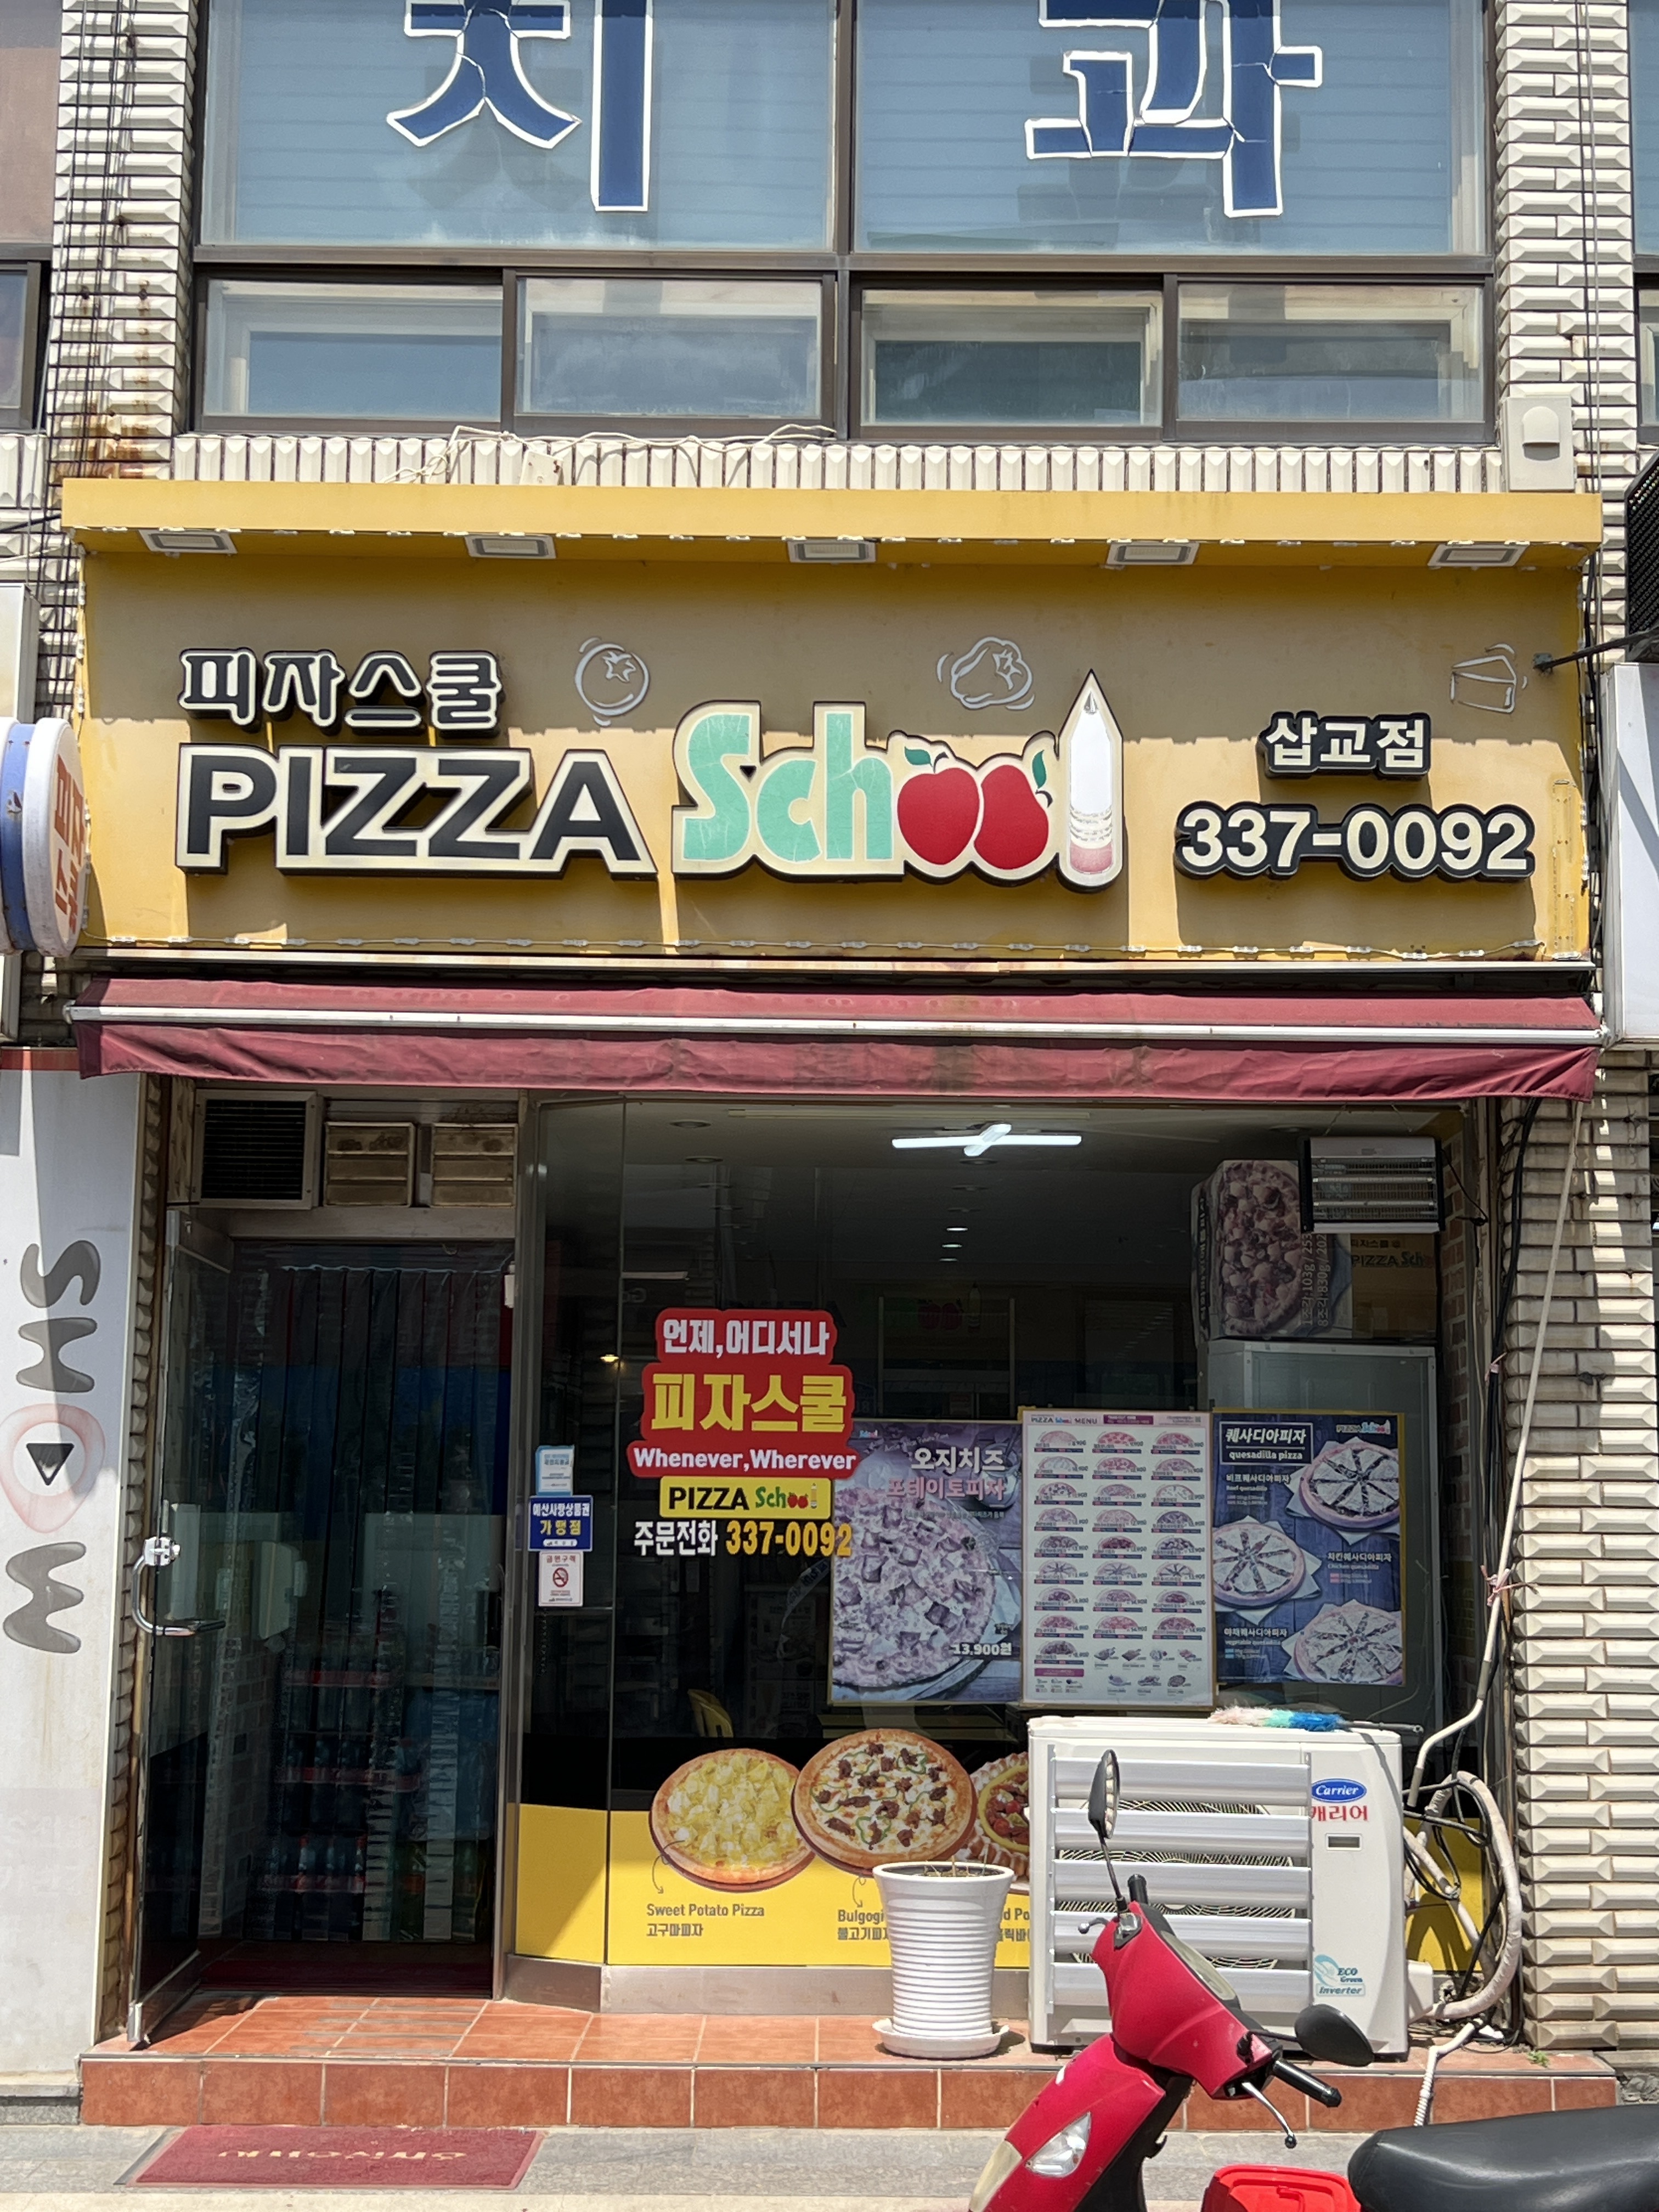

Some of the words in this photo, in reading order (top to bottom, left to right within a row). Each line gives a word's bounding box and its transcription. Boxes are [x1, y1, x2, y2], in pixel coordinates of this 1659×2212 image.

[180, 648, 501, 730] 피자스쿨
[1264, 715, 1427, 769] 삽교점
[181, 748, 650, 868] PIZZA
[1181, 808, 1528, 871] 337-0092
[651, 1373, 847, 1432] 피자스쿨
[1226, 1427, 1306, 1444] 퀘사디아피자
[911, 1446, 1006, 1475] 오지치즈
[1229, 1450, 1277, 1460] quesadilla
[1278, 1451, 1303, 1462] pizza
[668, 1486, 750, 1510] PIZZA
[887, 1477, 1006, 1501] 포테이토피자
[540, 1519, 582, 1536] 가맹점
[634, 1520, 719, 1556] 주문전화
[725, 1520, 853, 1556] 337-0092
[1315, 1784, 1359, 1796] Carrier
[646, 1903, 686, 1916] Sweet
[689, 1903, 729, 1916] Potato
[732, 1903, 765, 1916] Pizza
[837, 1909, 884, 1925] Bulgogi
[646, 1923, 704, 1937] 고구마피자
[1338, 1967, 1358, 1976] ECO
[1319, 1986, 1362, 1995] Inverter
